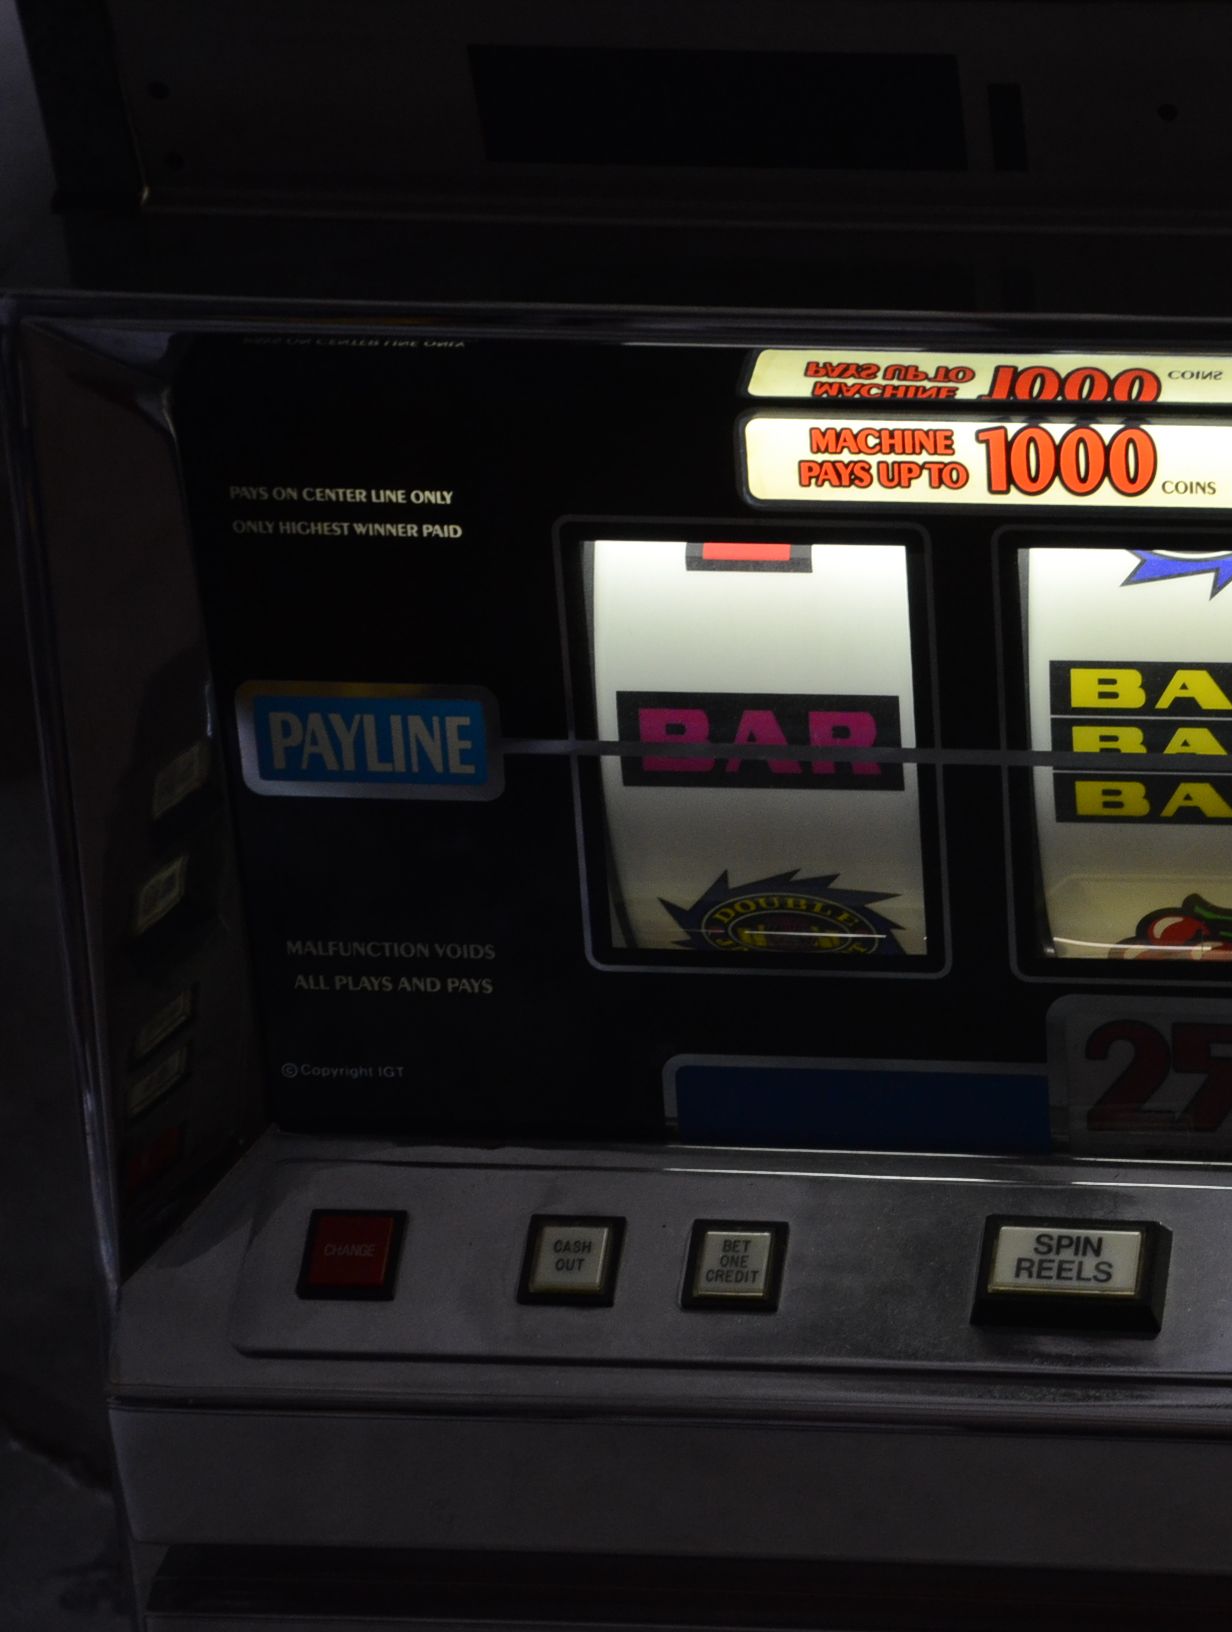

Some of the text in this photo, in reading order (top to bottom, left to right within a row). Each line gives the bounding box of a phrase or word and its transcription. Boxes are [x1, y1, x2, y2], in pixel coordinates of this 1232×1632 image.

[810, 427, 954, 456] MACHINE
[977, 425, 1157, 496] 1000
[799, 461, 871, 489] PAYS
[229, 485, 454, 505] PAYS ON CENTER LINE ONLY
[1161, 480, 1217, 495] COINS
[232, 519, 463, 539] ONLY HIGHEST WINNER PAID
[268, 711, 476, 775] PAYLINE
[638, 707, 881, 774] BAR
[712, 896, 860, 928] DOUBLE
[286, 940, 496, 960] MALFUNCTION VOIDS
[294, 974, 494, 994] ALL PLAYS AND PAYS
[378, 1065, 405, 1078] IGT
[323, 1243, 376, 1257] CHANGE
[553, 1239, 592, 1255] CASH
[722, 1239, 751, 1254] BET
[1034, 1233, 1103, 1257] SPIN
[555, 1258, 585, 1273] OUT
[720, 1255, 749, 1269] ONE
[1014, 1258, 1114, 1283] REELS
[705, 1269, 761, 1284] CREDIT
